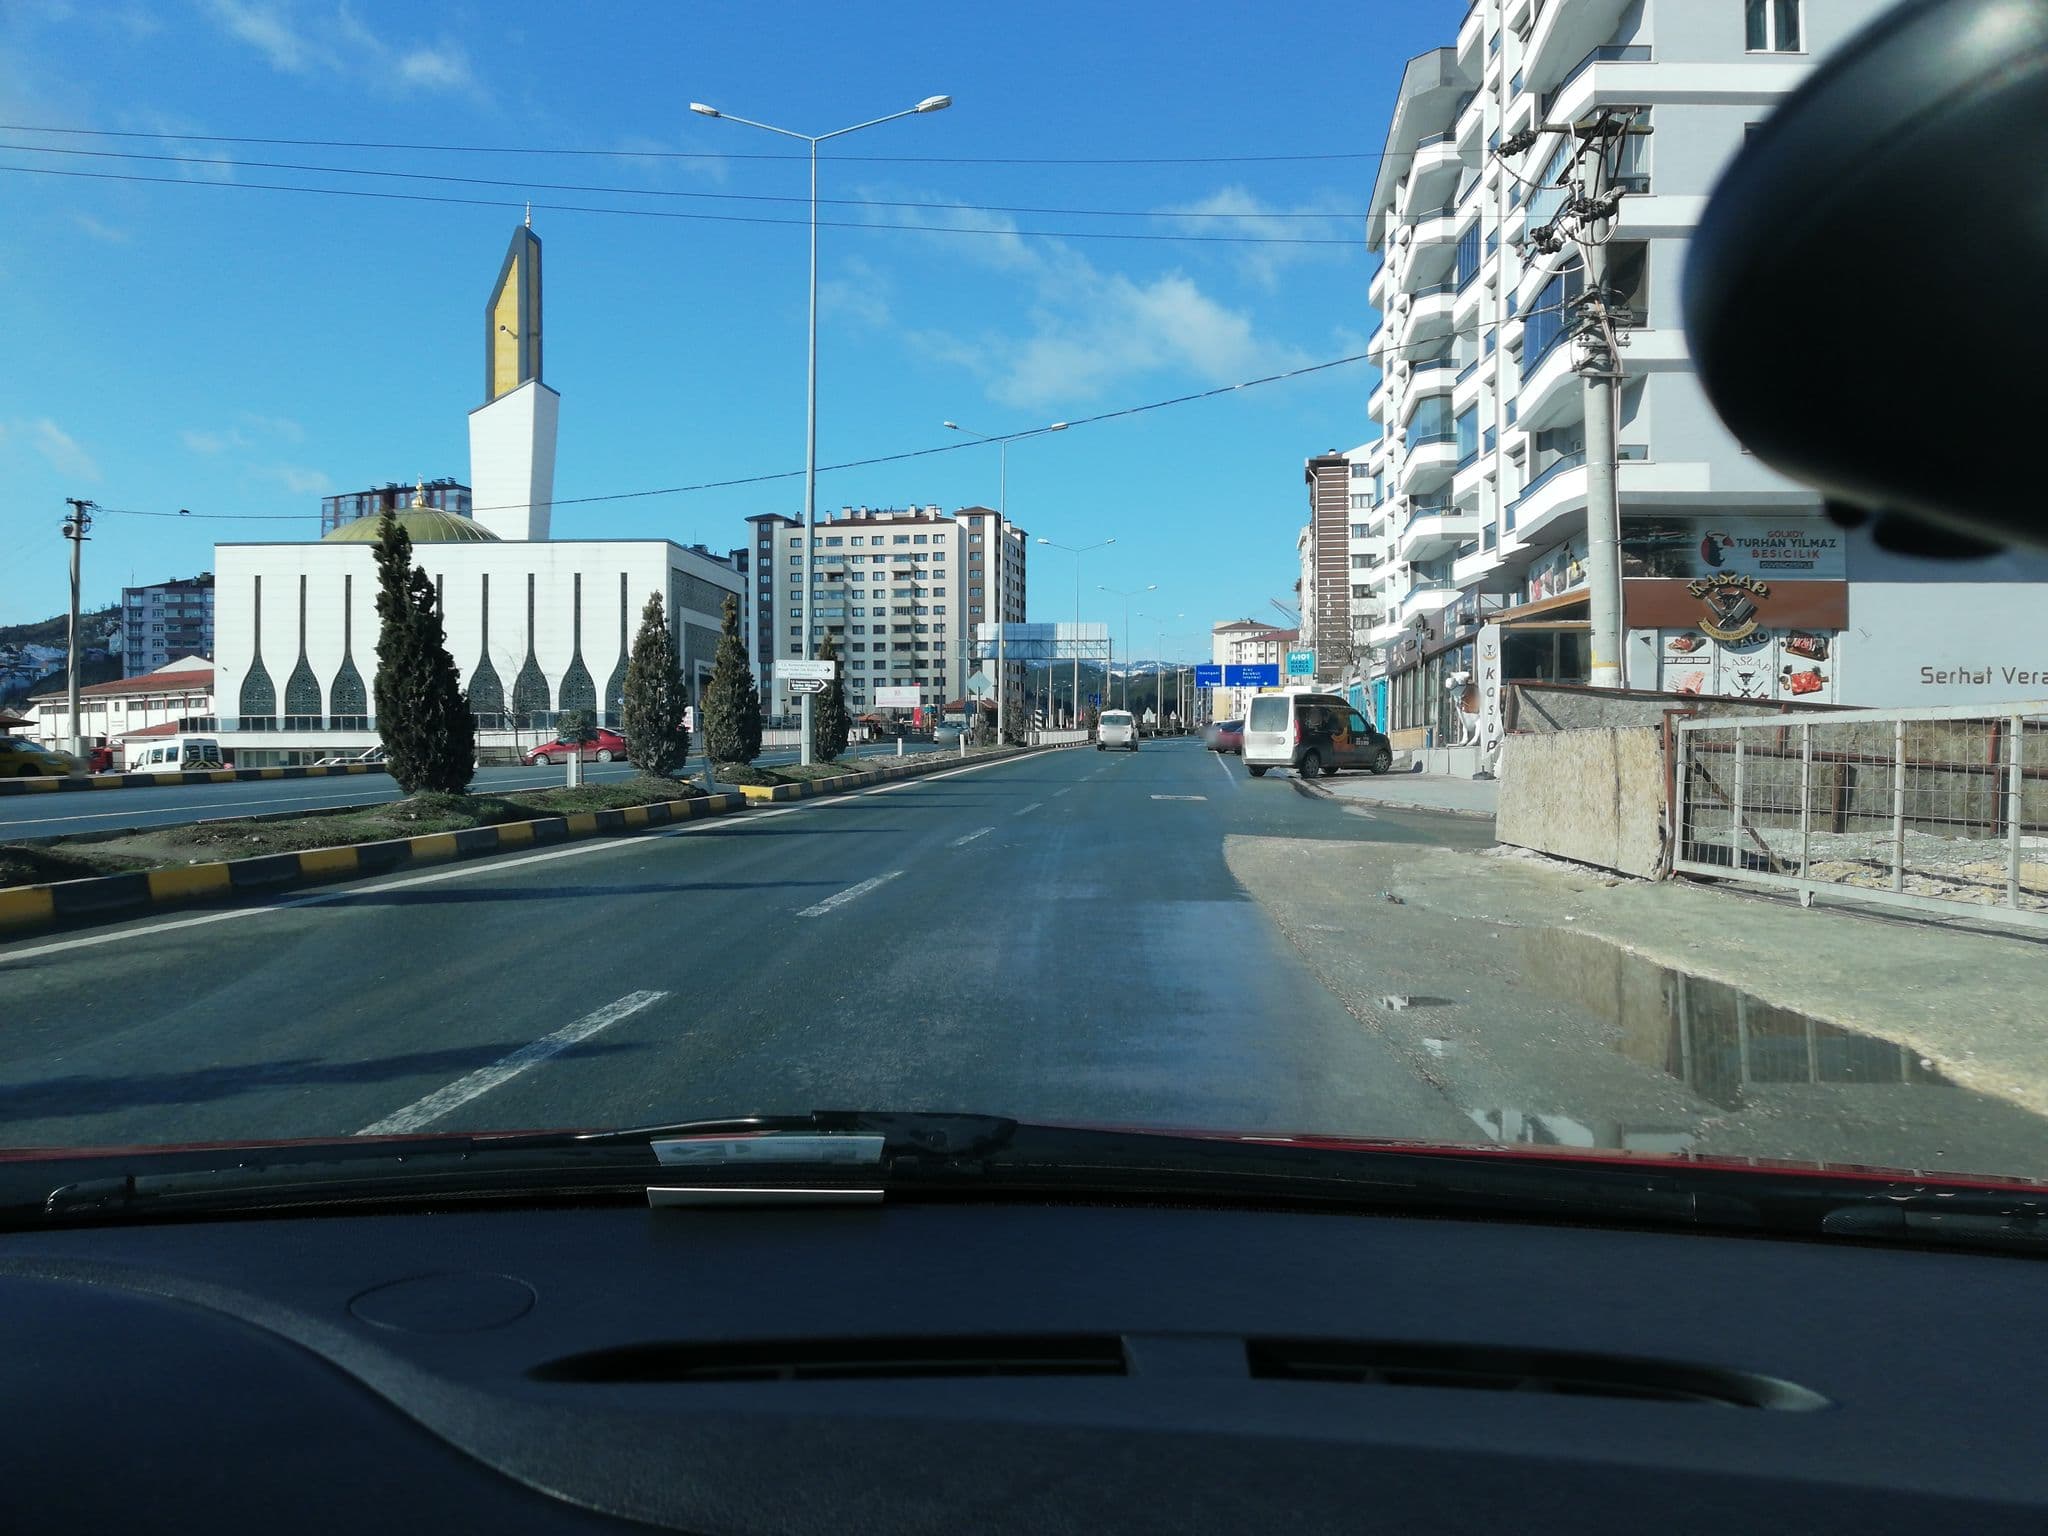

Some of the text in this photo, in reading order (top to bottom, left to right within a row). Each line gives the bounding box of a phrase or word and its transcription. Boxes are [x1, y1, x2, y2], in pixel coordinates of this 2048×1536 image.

[1736, 538, 1837, 548] TURHAN YILMAZ
[1920, 665, 1993, 685] Serhat
